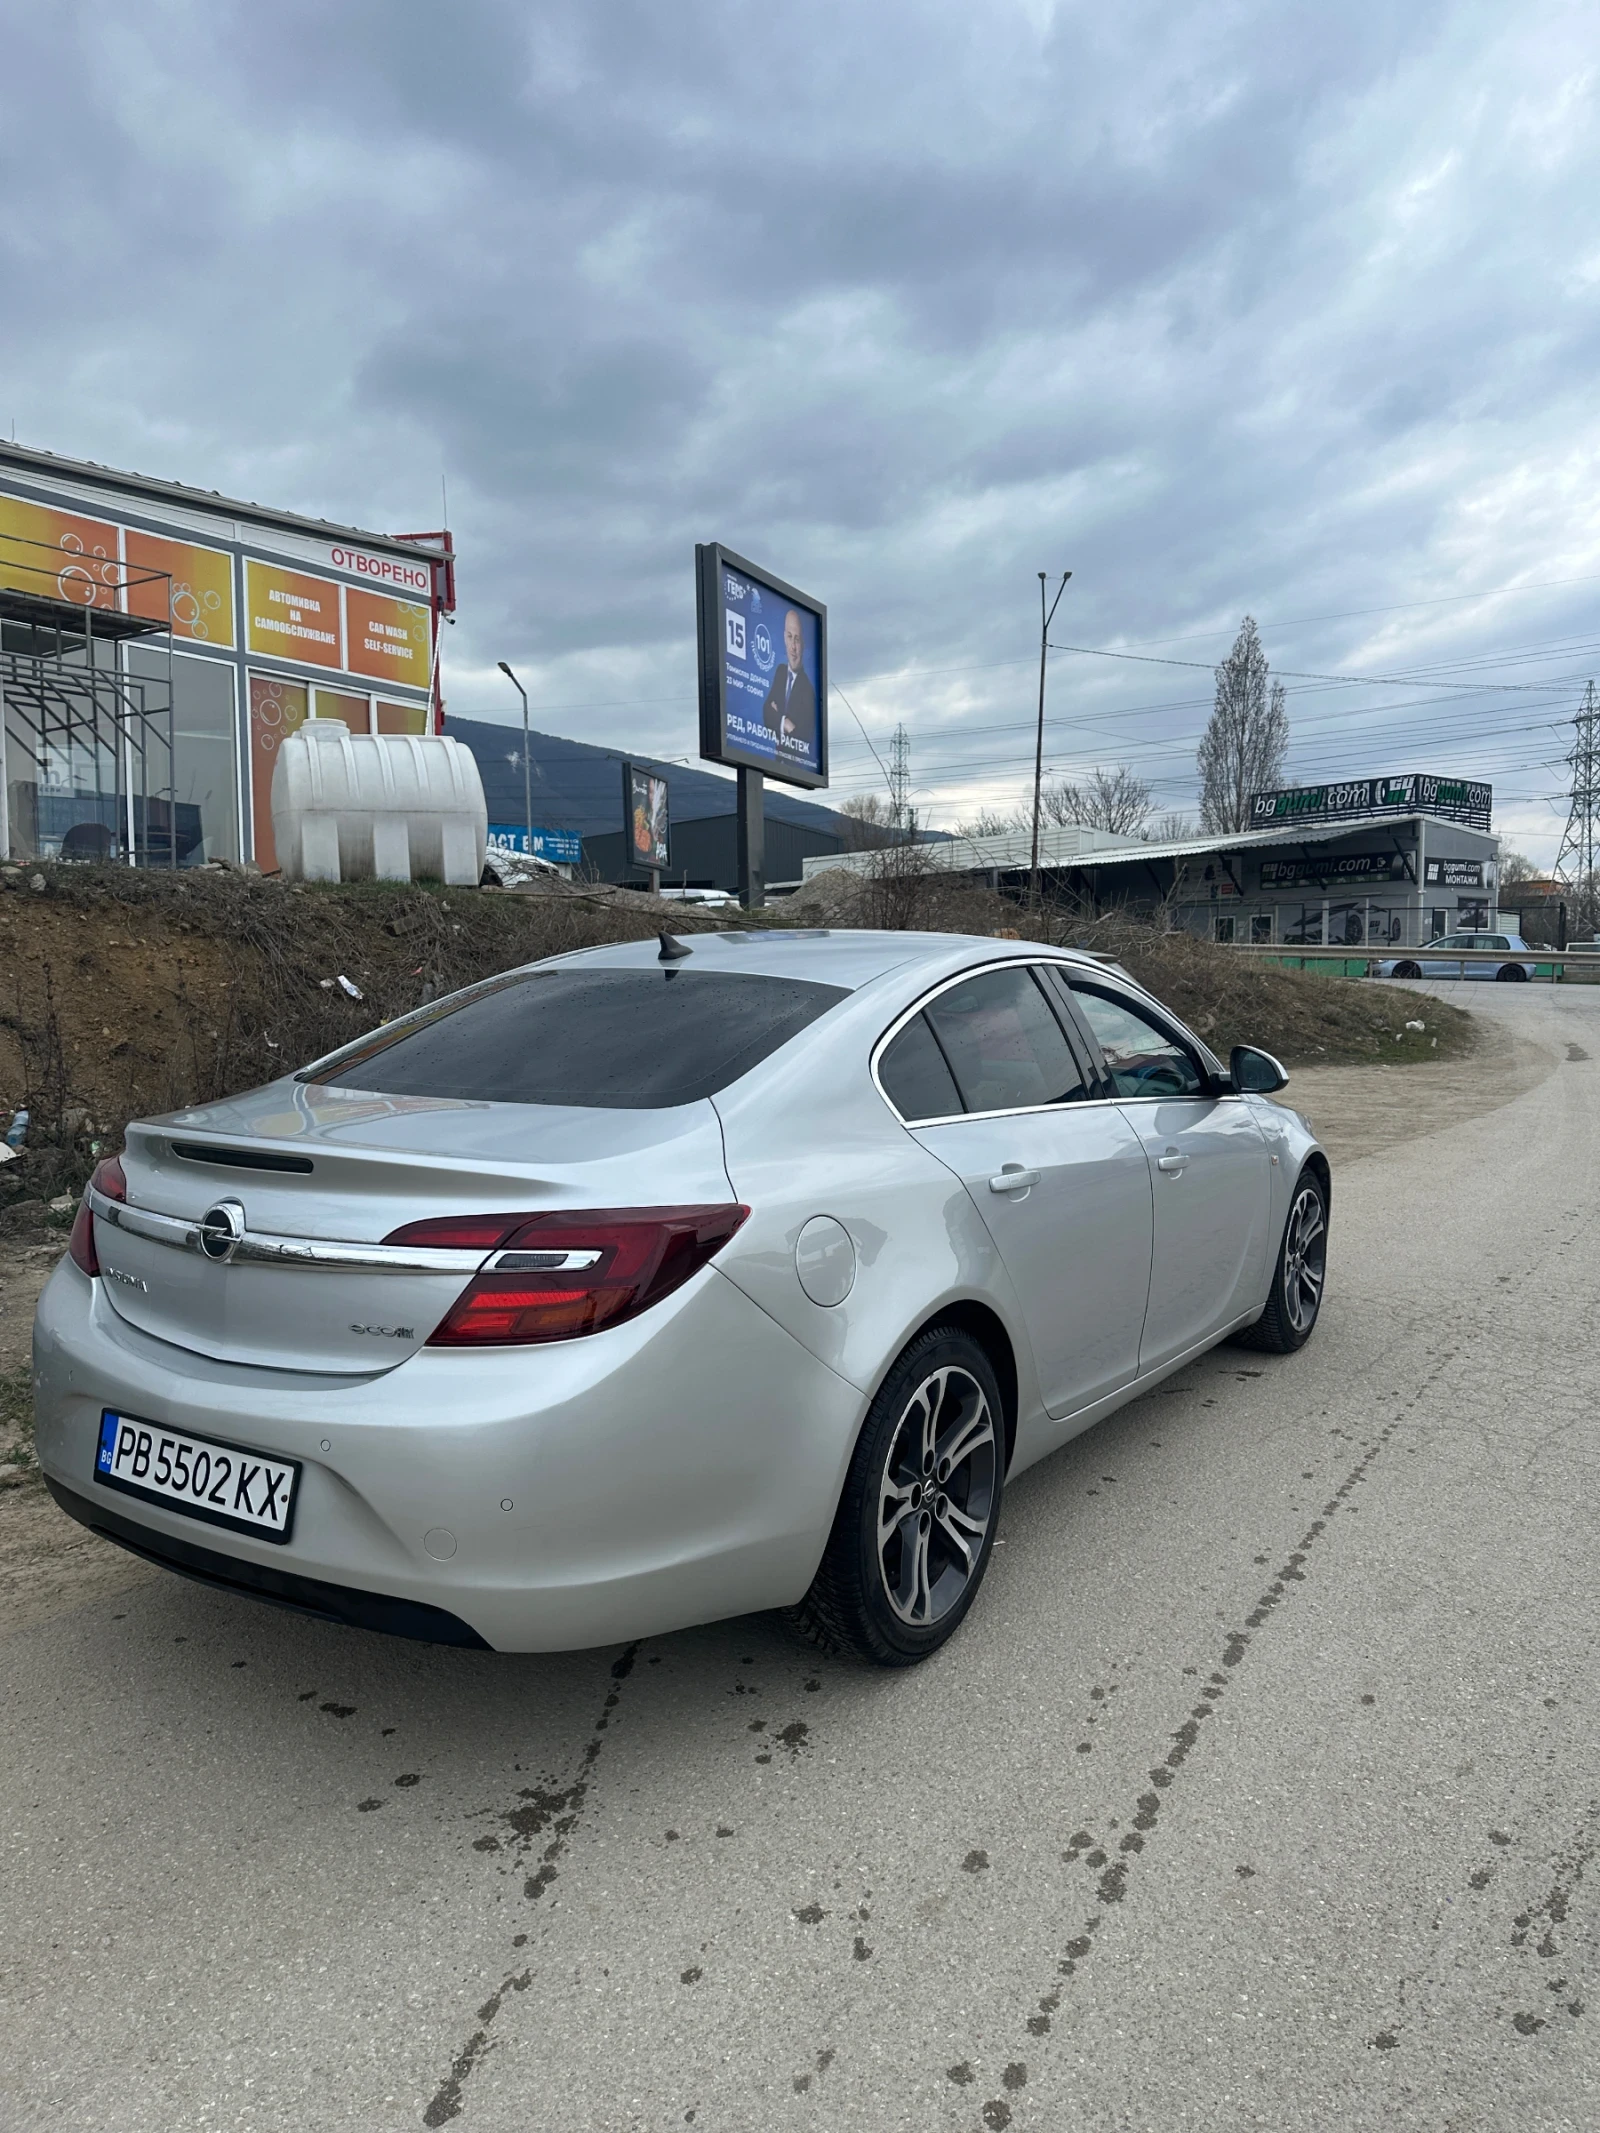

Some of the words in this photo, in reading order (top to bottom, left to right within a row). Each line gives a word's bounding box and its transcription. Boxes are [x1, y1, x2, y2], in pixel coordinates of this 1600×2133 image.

[331, 548, 427, 589] ОТВОРЕНО
[269, 589, 321, 613] АВТОМИВКА
[290, 609, 302, 622] НА
[254, 616, 336, 645] САМООБСЛУЖВАНЕ
[369, 621, 385, 636] CAR
[385, 625, 408, 640] WASH
[728, 620, 744, 649] 15
[364, 638, 413, 659] SELF-SERVICE
[756, 634, 770, 654] 101
[727, 713, 746, 734] РЕД,
[746, 720, 780, 746] РАБОТА,
[780, 733, 810, 755] РАСТЕЖ
[1443, 860, 1480, 873] bggumi.com
[1445, 874, 1478, 885] МОНТАЖИ
[100, 1450, 112, 1465] BG
